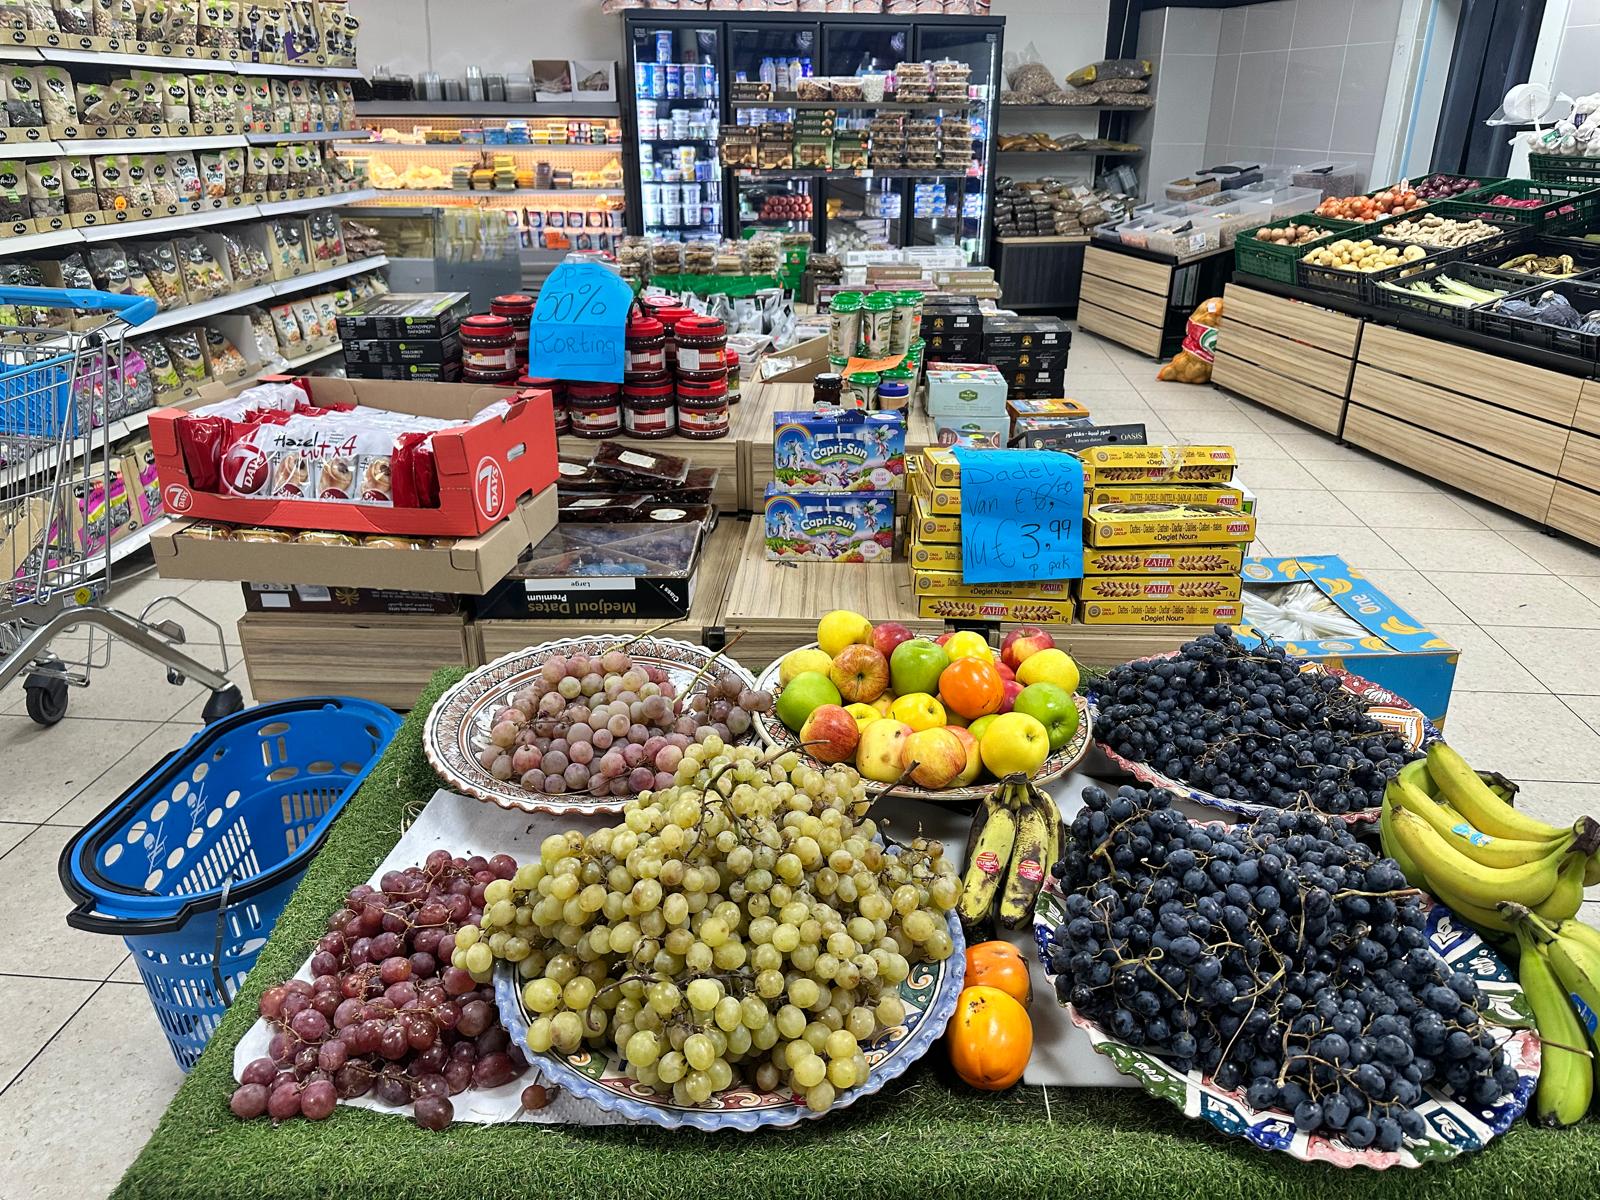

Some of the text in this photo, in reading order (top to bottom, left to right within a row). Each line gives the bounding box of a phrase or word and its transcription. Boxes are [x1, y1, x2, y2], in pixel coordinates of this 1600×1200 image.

[537, 284, 607, 324] 50%
[273, 432, 318, 447] Hazel
[1120, 433, 1143, 441] OASIS
[300, 441, 331, 462] nut
[811, 443, 868, 461] Capri-Sun
[229, 449, 258, 488] 7
[244, 456, 265, 488] DAYS
[961, 459, 1073, 485] Dadels
[479, 465, 494, 513] 7
[491, 466, 499, 508] DAYS
[169, 488, 182, 507] 7
[967, 489, 999, 517] Van
[800, 515, 857, 532] Capri-Sun
[1226, 524, 1250, 532] ZAHIA
[965, 518, 1072, 570] Nu € 3,99
[1048, 555, 1071, 575] pak
[1144, 558, 1174, 567] ZAHIA
[570, 580, 592, 588] Large
[970, 588, 994, 596] «Deglet
[1144, 585, 1174, 594] ZAHIA
[527, 594, 567, 603] Premium
[664, 588, 680, 603] Class
[528, 601, 637, 616] Medjoul Dates
[980, 606, 1008, 615] ZAHIA
